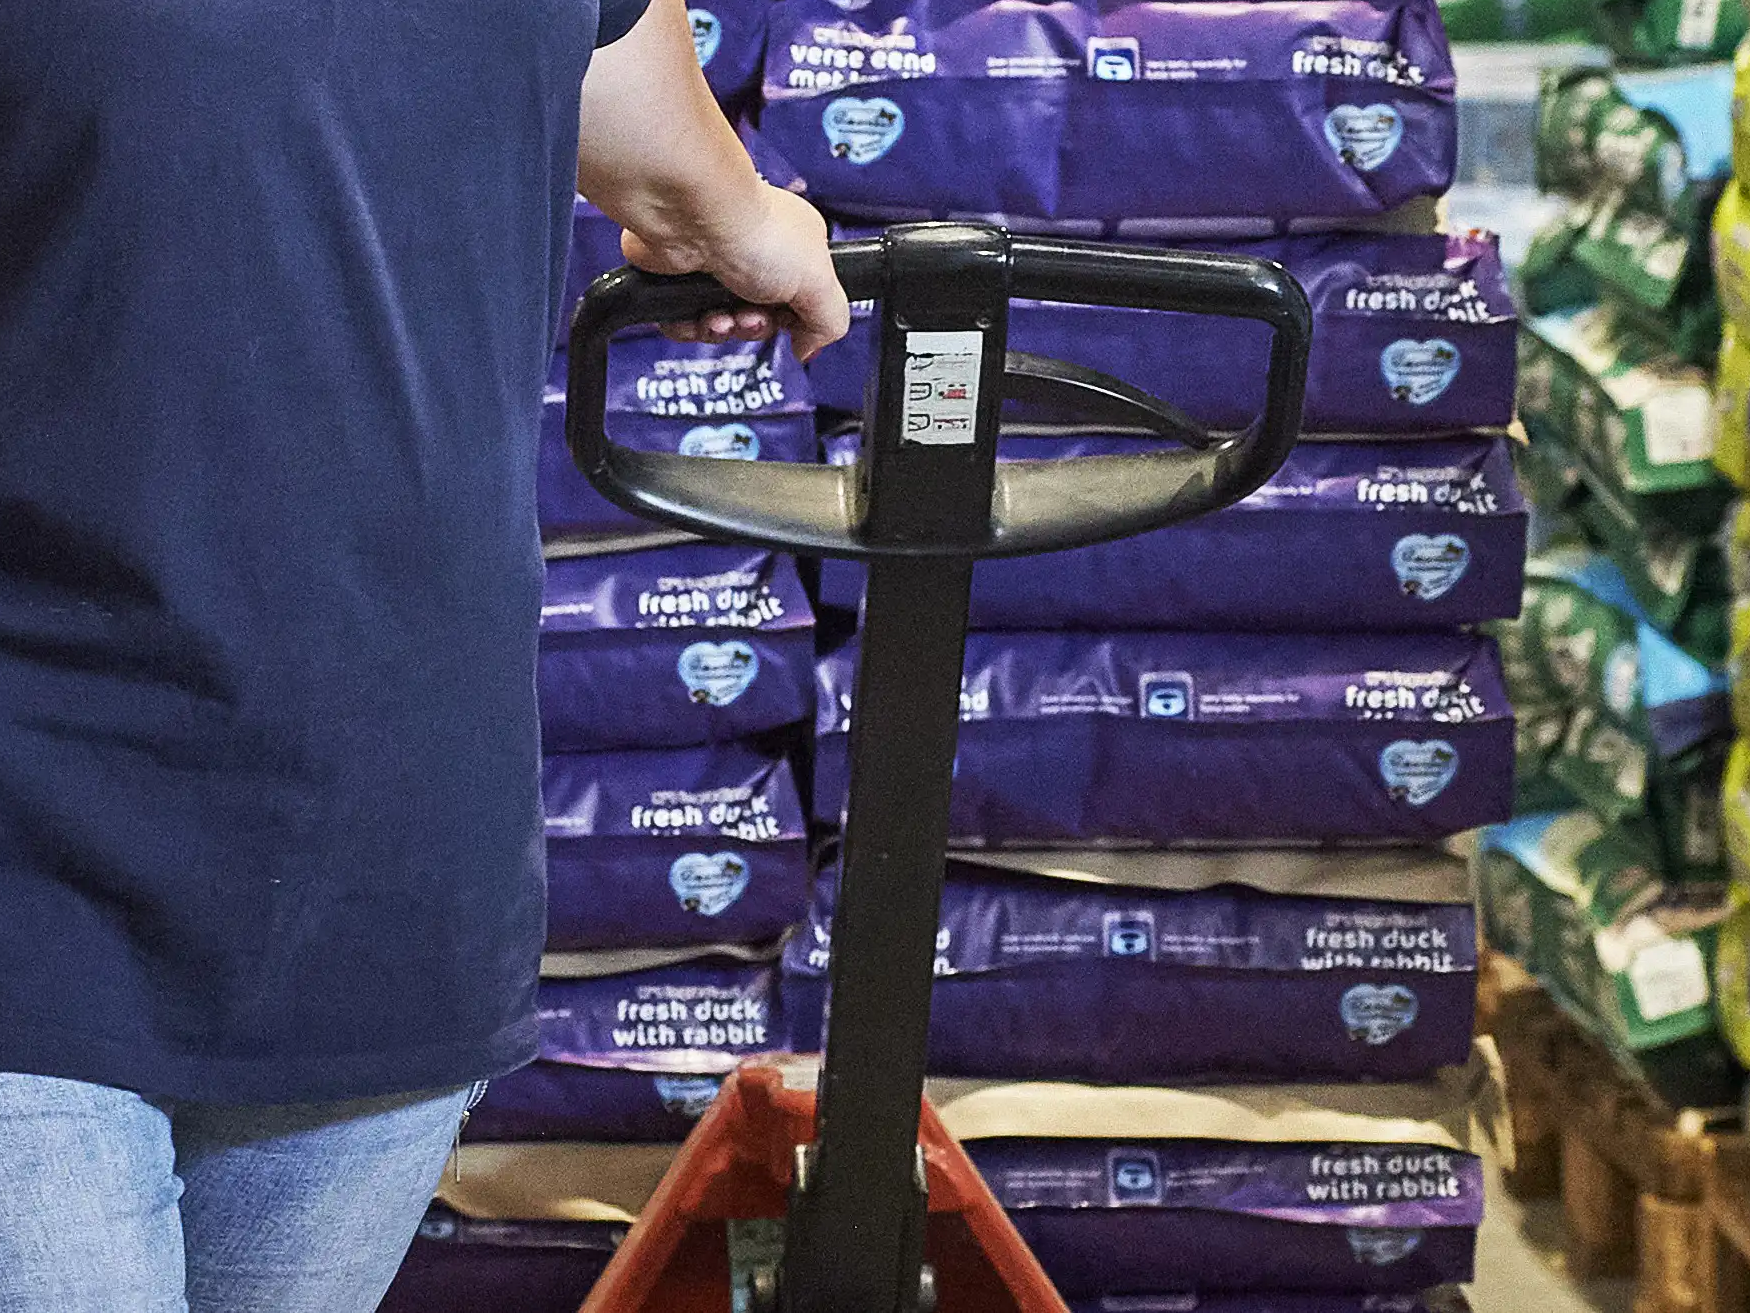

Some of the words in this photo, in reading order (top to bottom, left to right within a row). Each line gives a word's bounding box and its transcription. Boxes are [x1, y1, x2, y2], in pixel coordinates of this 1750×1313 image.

[789, 42, 866, 70] verse
[868, 48, 938, 75] eend
[1291, 49, 1363, 78] fresh
[1345, 287, 1417, 311] fresh
[635, 373, 709, 399] fresh
[1356, 476, 1430, 506] fresh
[637, 590, 710, 616] fresh
[1344, 683, 1418, 711] fresh
[630, 805, 703, 829] fresh
[1304, 926, 1376, 950] fresh
[1379, 927, 1450, 951] duck
[616, 998, 688, 1023] fresh
[693, 998, 764, 1022] duck
[611, 1023, 677, 1048] with
[682, 1022, 768, 1047] rabbit
[1310, 1153, 1382, 1177] fresh
[1385, 1153, 1451, 1176] duck
[1305, 1178, 1370, 1202] with
[1373, 1175, 1461, 1201] rabbit
